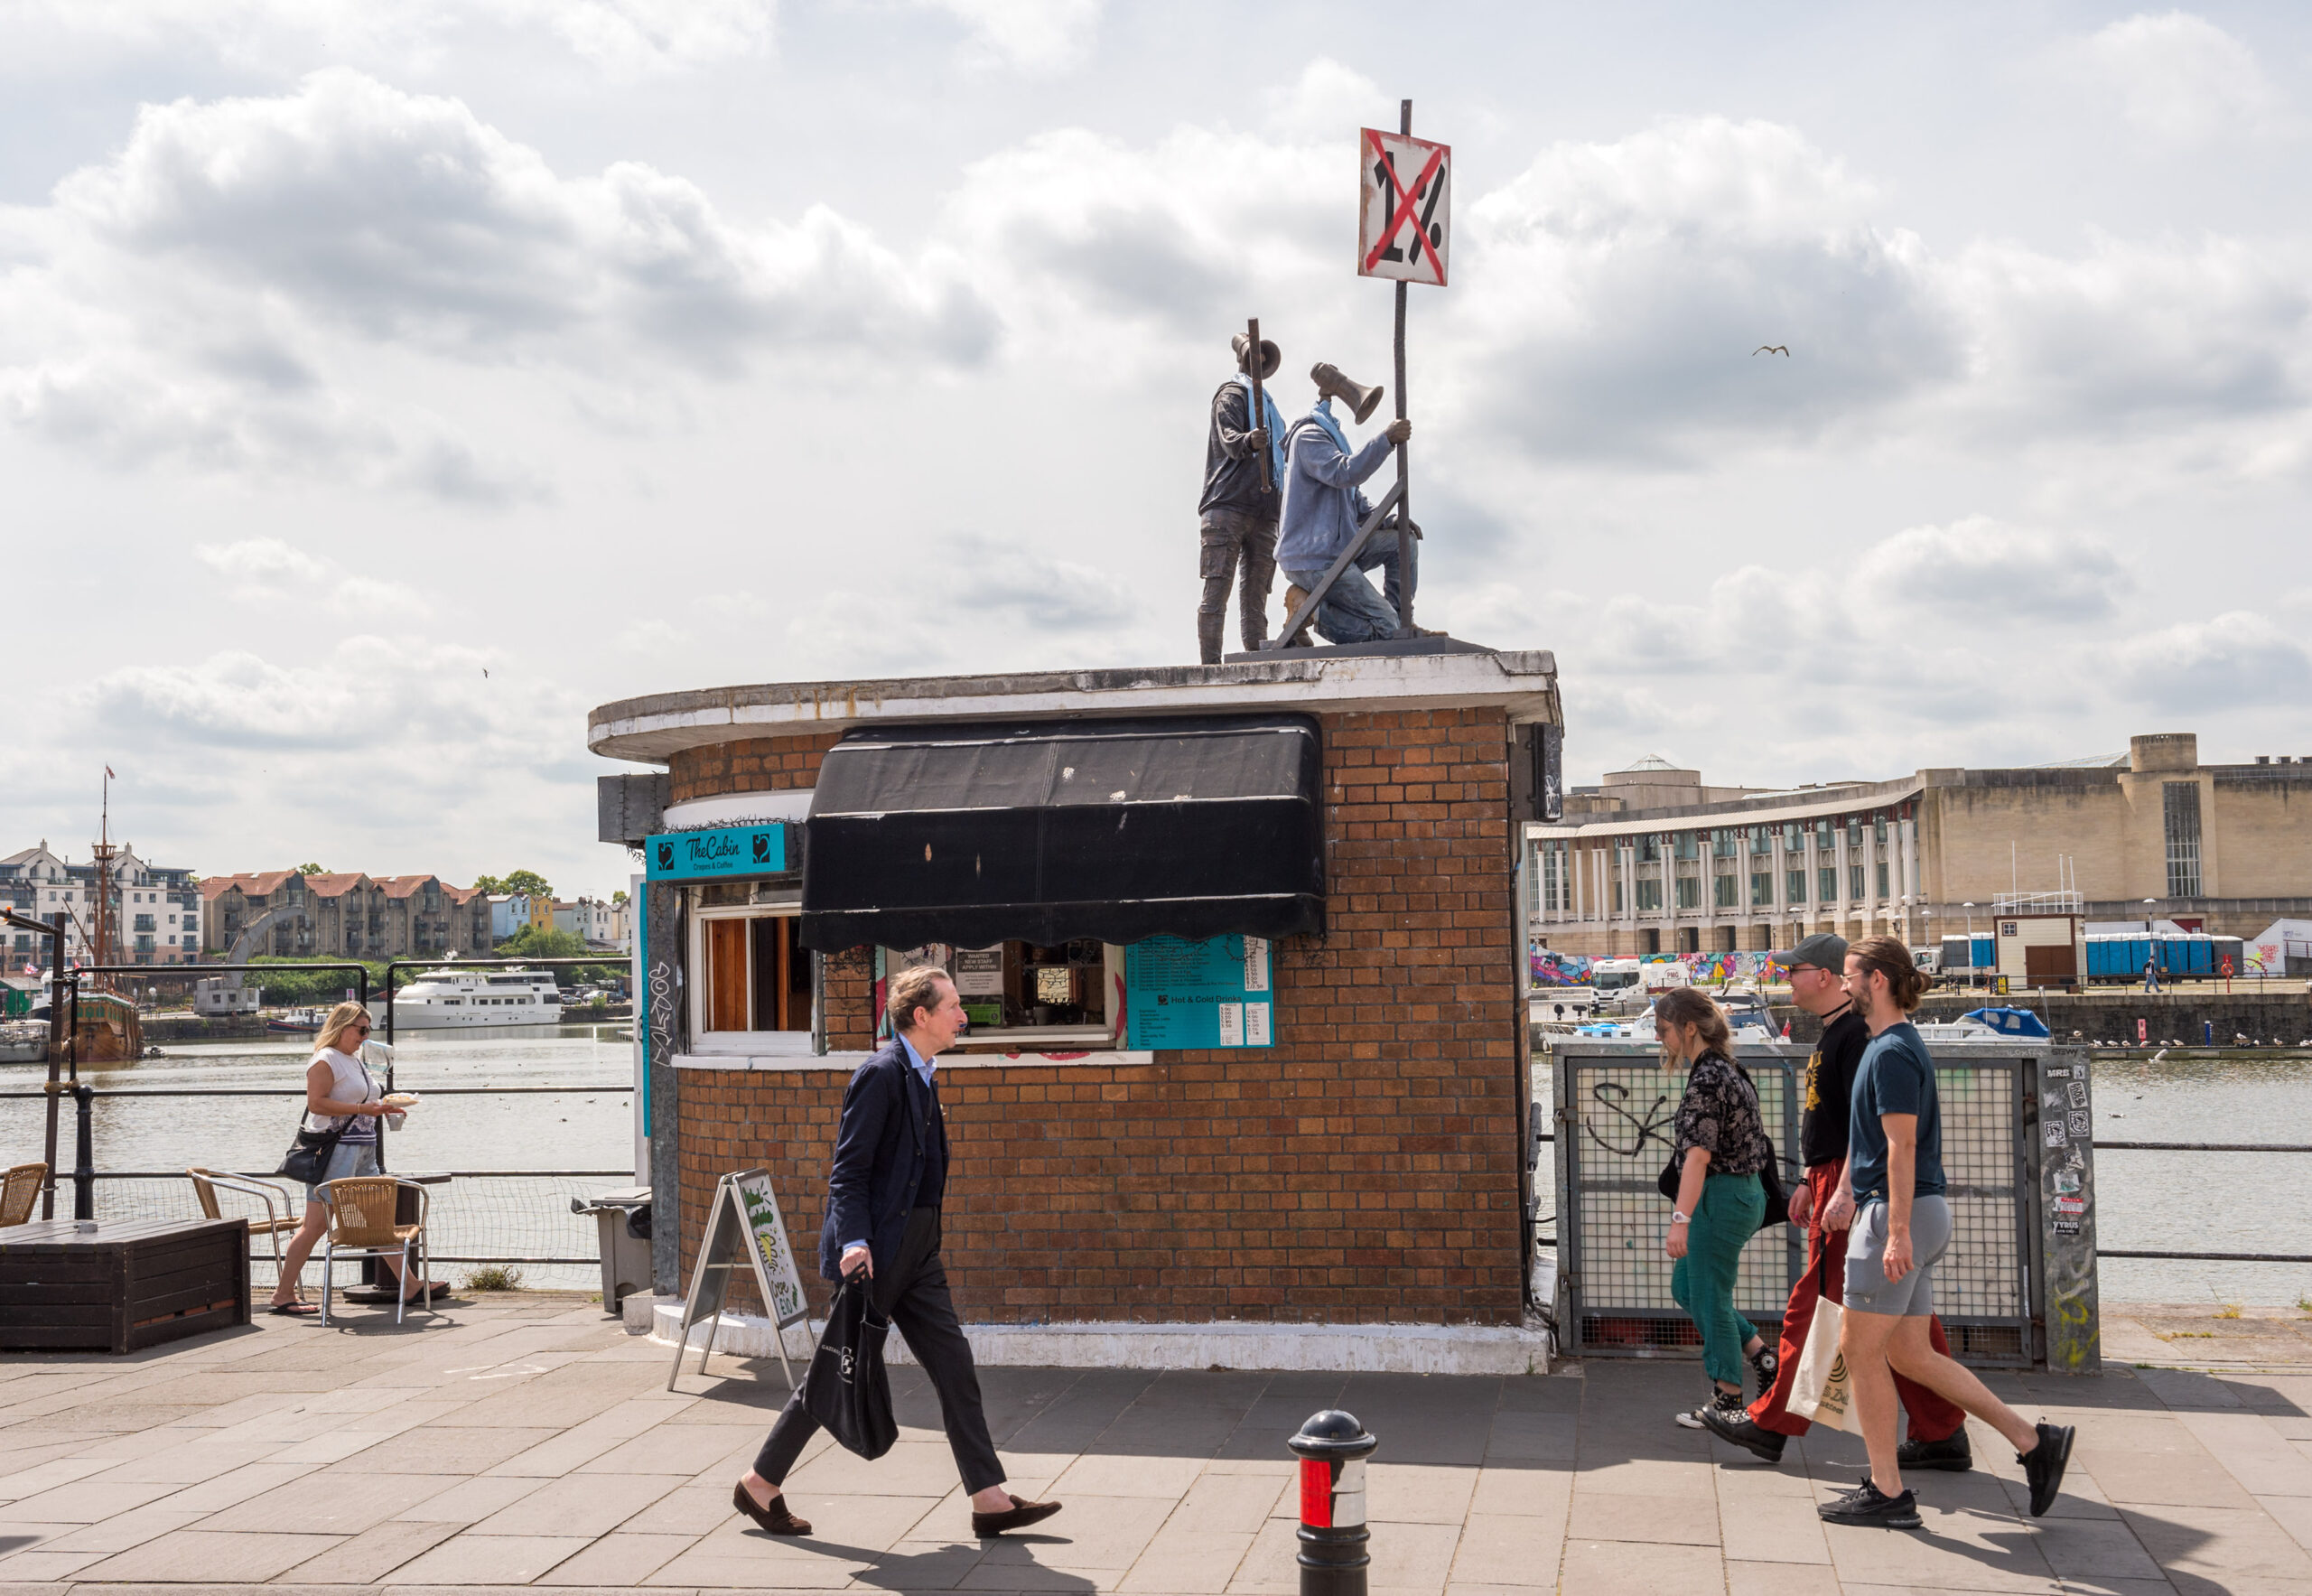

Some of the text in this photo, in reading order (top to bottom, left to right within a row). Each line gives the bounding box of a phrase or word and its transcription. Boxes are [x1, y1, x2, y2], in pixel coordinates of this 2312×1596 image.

[1374, 151, 1445, 266] 1%
[694, 863, 711, 872] Crepes
[717, 861, 733, 869] Coffee
